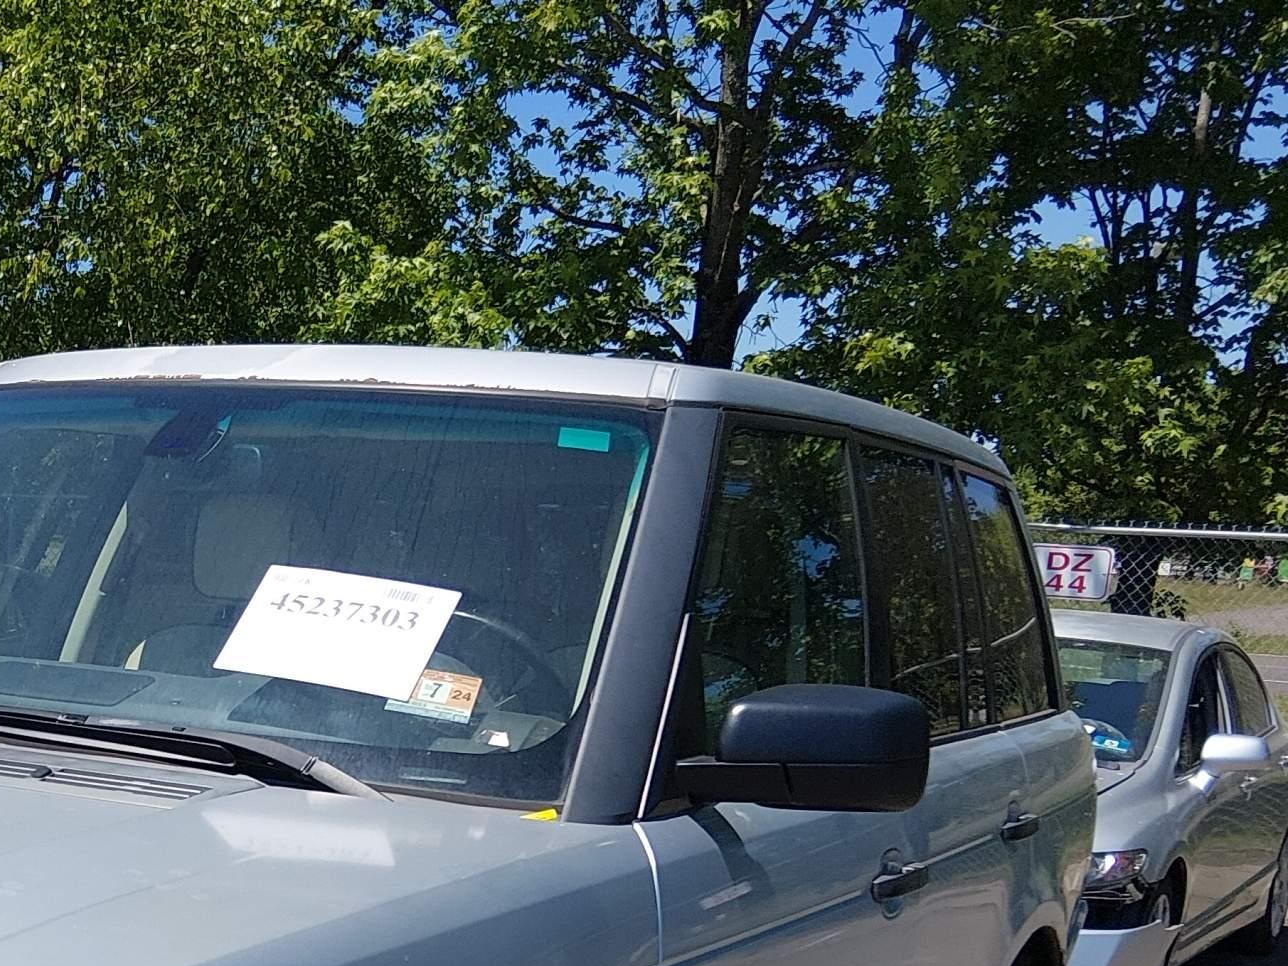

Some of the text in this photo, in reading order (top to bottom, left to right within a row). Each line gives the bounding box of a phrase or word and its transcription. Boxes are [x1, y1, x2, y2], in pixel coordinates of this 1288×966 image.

[1046, 551, 1094, 572] DZ
[1044, 574, 1087, 593] 44
[270, 593, 420, 631] 45237303
[430, 682, 472, 702] 7 24
